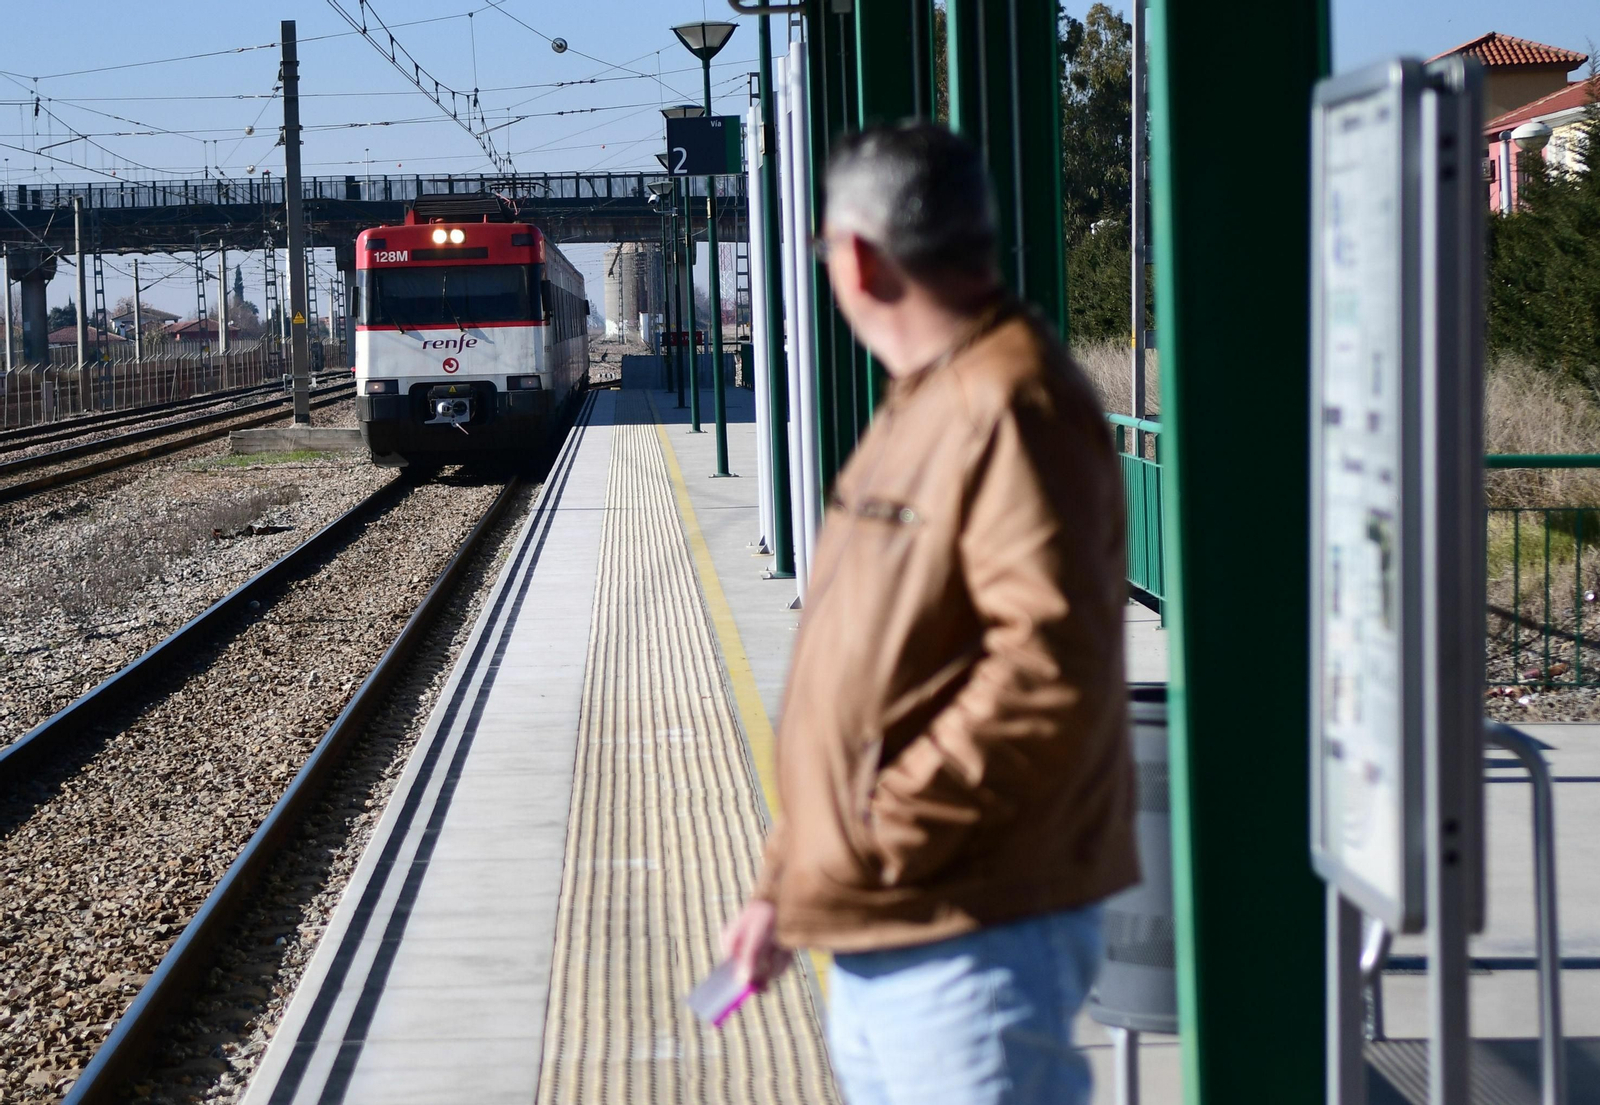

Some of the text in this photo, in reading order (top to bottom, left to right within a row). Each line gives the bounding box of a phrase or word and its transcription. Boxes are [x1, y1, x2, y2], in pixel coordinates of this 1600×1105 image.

[672, 146, 688, 174] 2
[373, 250, 408, 263] 128M
[422, 333, 478, 354] renfe
